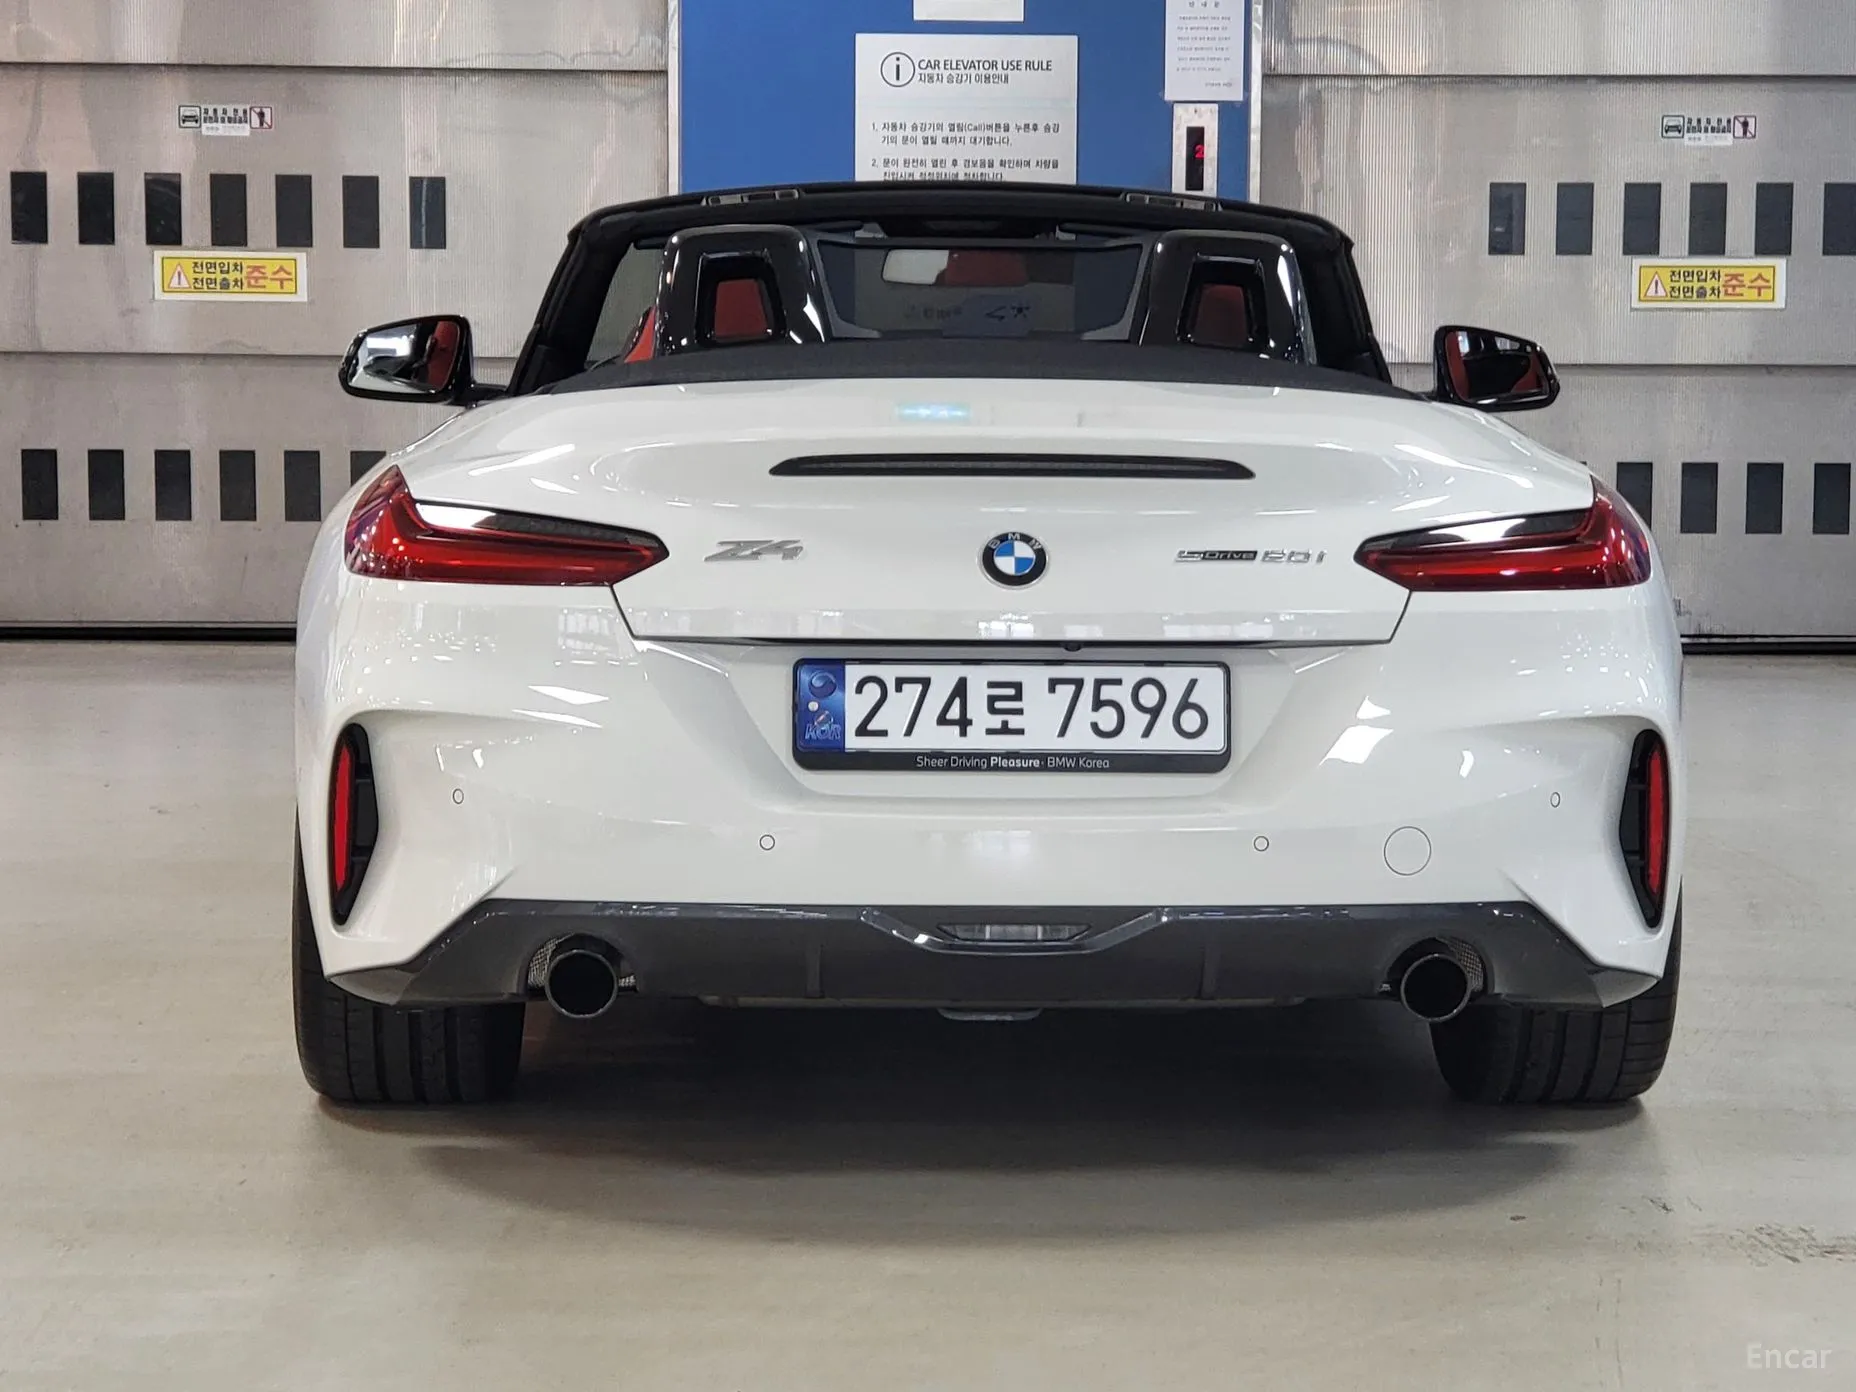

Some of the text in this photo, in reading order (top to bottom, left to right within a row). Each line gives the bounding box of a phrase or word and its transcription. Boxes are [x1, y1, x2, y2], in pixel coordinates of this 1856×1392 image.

[918, 59, 1052, 72] CAR ELEVATOR USE RULE
[918, 73, 1009, 84] 자동차 승강기 이용안내
[881, 122, 907, 132] 자동차
[192, 261, 243, 274] 전면입차
[245, 264, 294, 290] 준수
[1669, 269, 1721, 283] 전면입차
[1722, 272, 1772, 297] 준수
[988, 533, 1042, 549] BMW
[703, 539, 803, 562] Z4
[854, 676, 1209, 739] 274로 7596
[805, 722, 841, 740] KOR
[916, 756, 948, 768] Sheer
[950, 756, 987, 769] Driving
[1047, 757, 1076, 768] BMW
[1079, 757, 1110, 769] Korea
